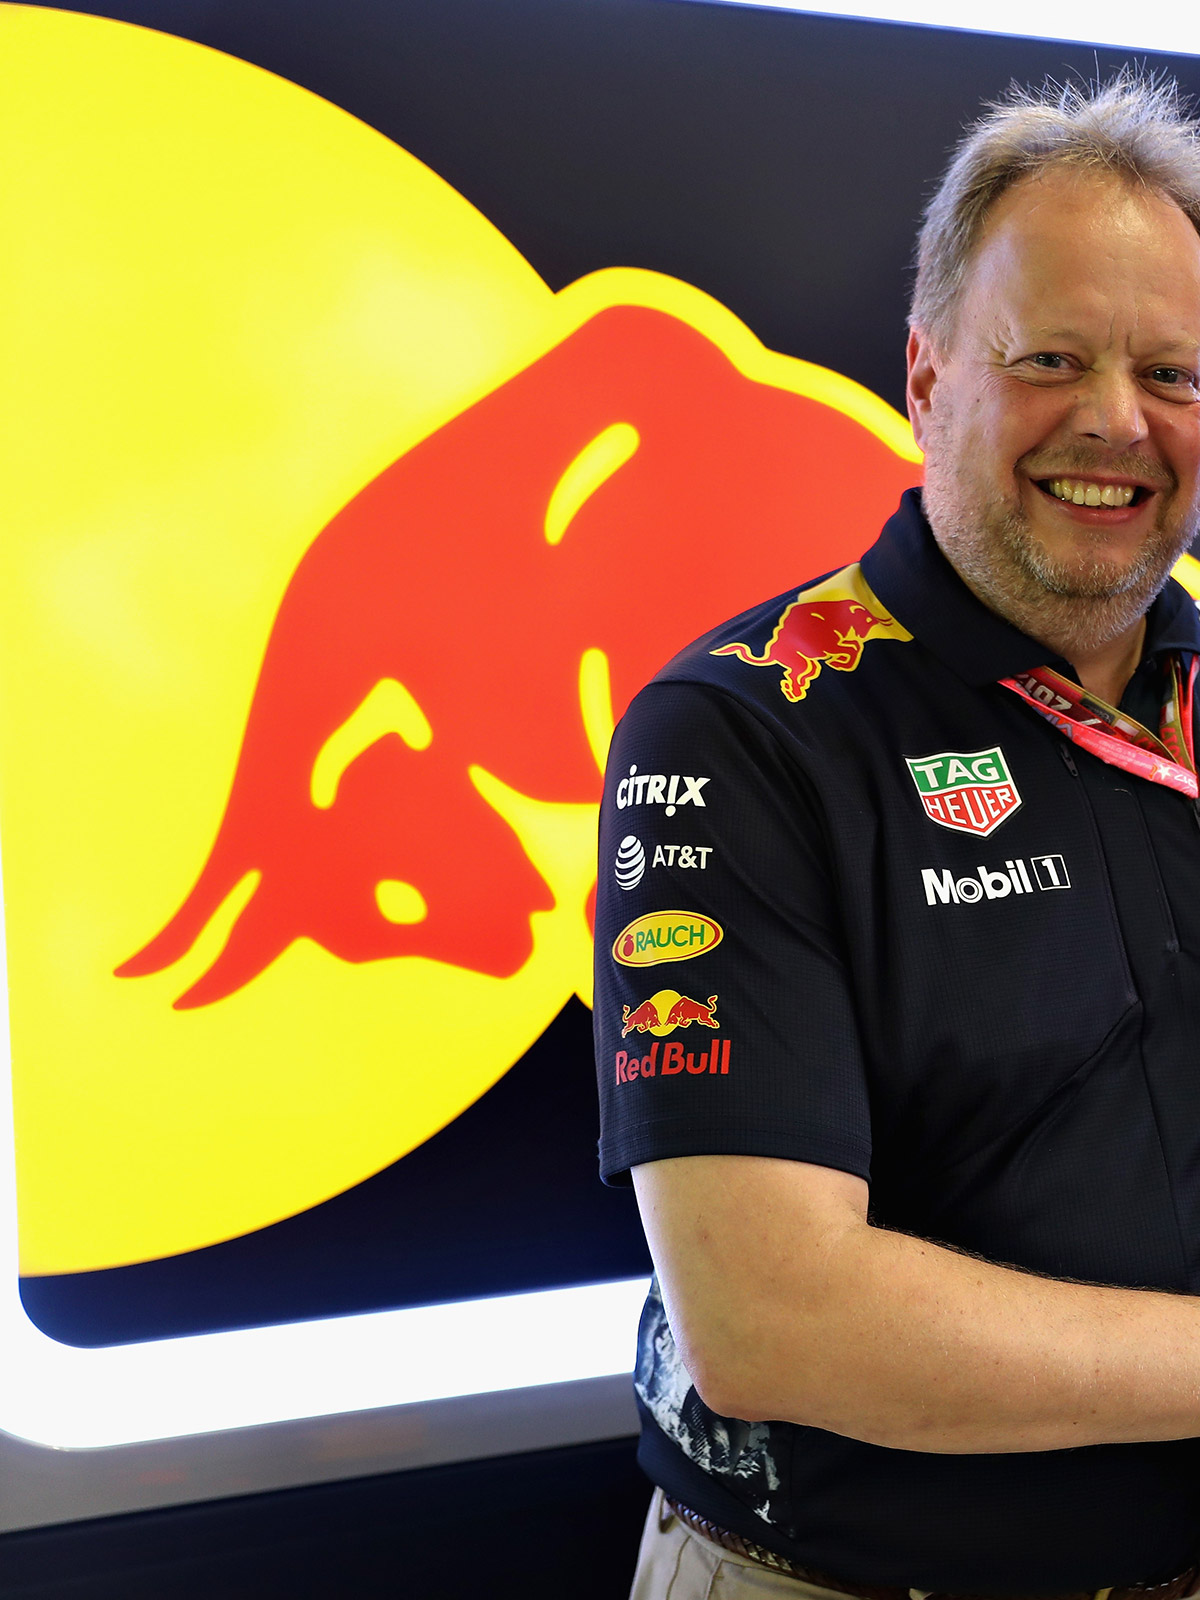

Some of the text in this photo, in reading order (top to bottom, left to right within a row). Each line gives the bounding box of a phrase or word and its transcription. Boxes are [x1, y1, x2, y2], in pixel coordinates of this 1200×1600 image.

[914, 757, 1002, 790] TAG
[924, 786, 1016, 829] HEUER
[652, 844, 713, 870] AT&T
[920, 858, 1062, 906] Mobil 1
[635, 924, 705, 953] RAUCH
[615, 1039, 731, 1086] Red Bull
